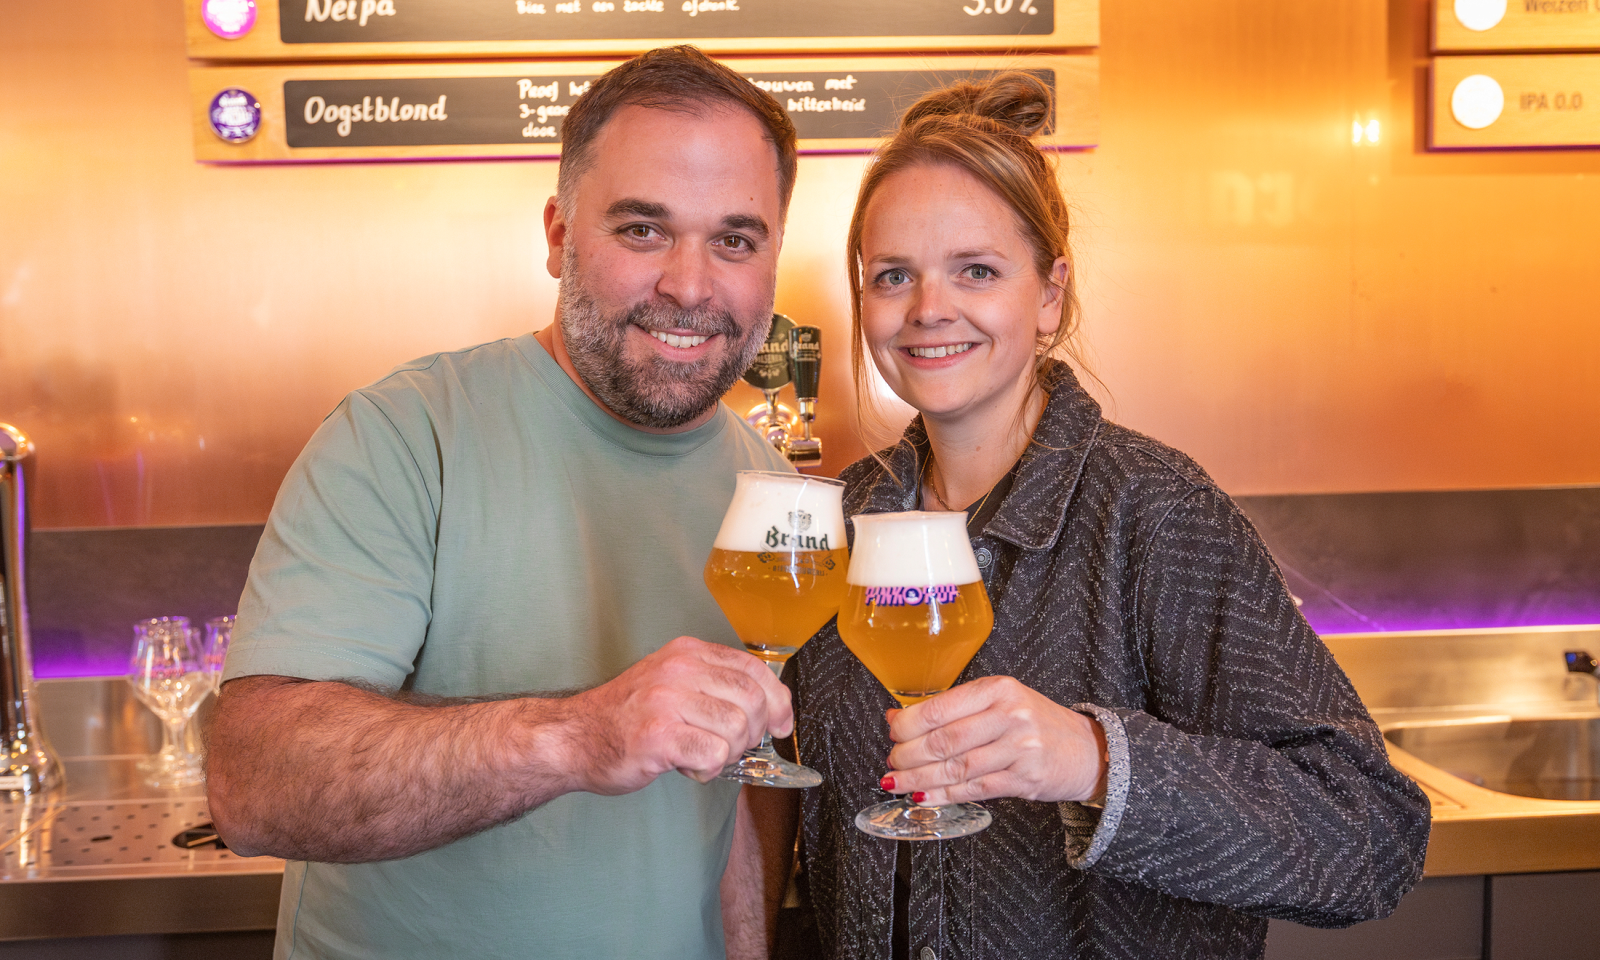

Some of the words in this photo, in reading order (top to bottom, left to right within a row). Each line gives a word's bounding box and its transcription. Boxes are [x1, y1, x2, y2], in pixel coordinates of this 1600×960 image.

[304, 0, 396, 27] Neipa
[555, 0, 581, 13] met
[591, 1, 615, 13] een
[516, 78, 559, 102] Proef
[825, 74, 858, 91] met
[787, 96, 867, 113] bitterheid
[1520, 92, 1548, 110] IPA
[1554, 91, 1583, 110] 0.0
[304, 94, 448, 137] Oogstblond
[522, 121, 558, 138] door
